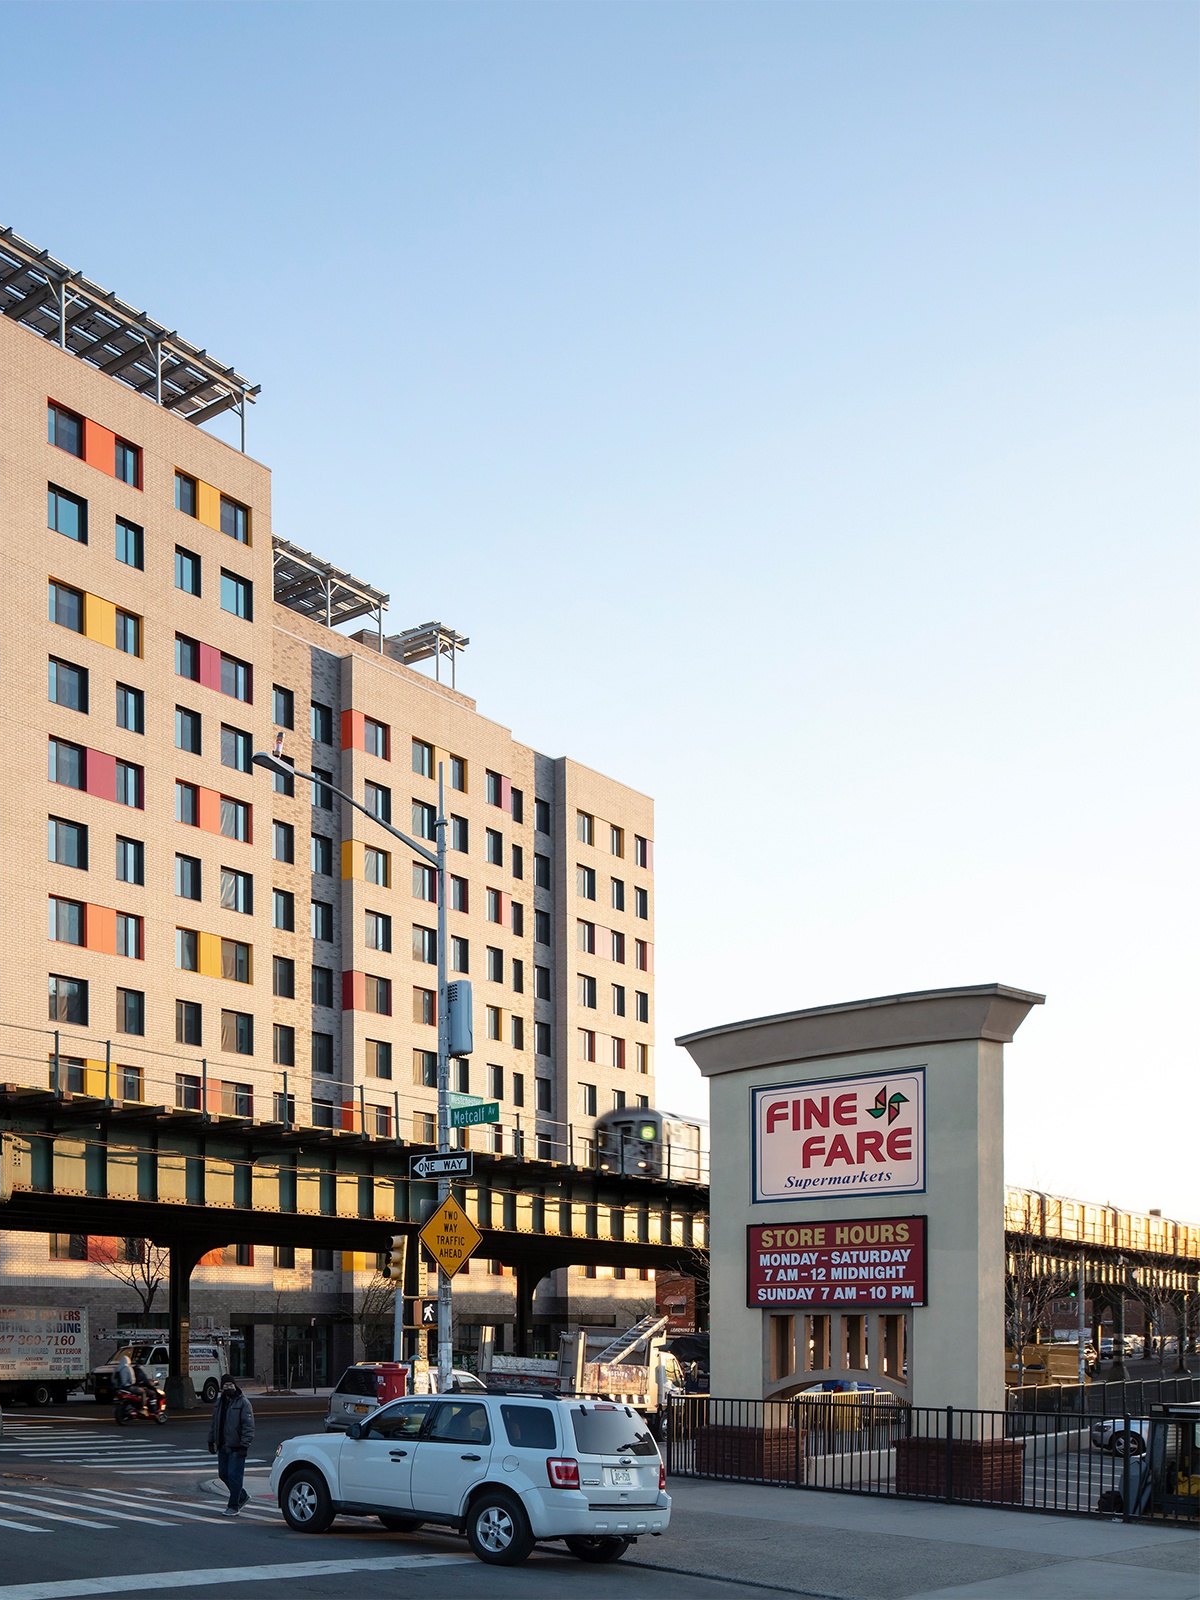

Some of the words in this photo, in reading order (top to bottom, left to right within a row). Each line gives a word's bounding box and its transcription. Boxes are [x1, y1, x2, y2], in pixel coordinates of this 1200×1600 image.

[453, 1107, 485, 1125] Metcalf
[487, 1106, 496, 1115] Av
[766, 1092, 858, 1134] FINE
[802, 1127, 912, 1169] FARE
[418, 1162, 435, 1172] ONE
[443, 1159, 464, 1170] WAY
[784, 1170, 892, 1190] Supermarkets
[443, 1210, 458, 1221] TWO
[443, 1223, 458, 1233] WAY
[761, 1228, 826, 1248] STORE
[835, 1223, 910, 1245] HOURS
[436, 1235, 465, 1246] TRAFFIC
[439, 1248, 463, 1259] AHEAD
[759, 1252, 819, 1267] MONDAY
[830, 1249, 911, 1265] SATURDAY
[764, 1269, 773, 1282] 7
[776, 1268, 798, 1281] AM
[810, 1267, 826, 1280] 12
[830, 1265, 906, 1280] MIDNIGHT
[757, 1287, 815, 1301] SUNDAY
[821, 1287, 830, 1300] 7
[833, 1287, 856, 1300] AM
[869, 1286, 887, 1299] 10
[891, 1285, 915, 1299] PM
[46, 1322, 81, 1334] SIDING
